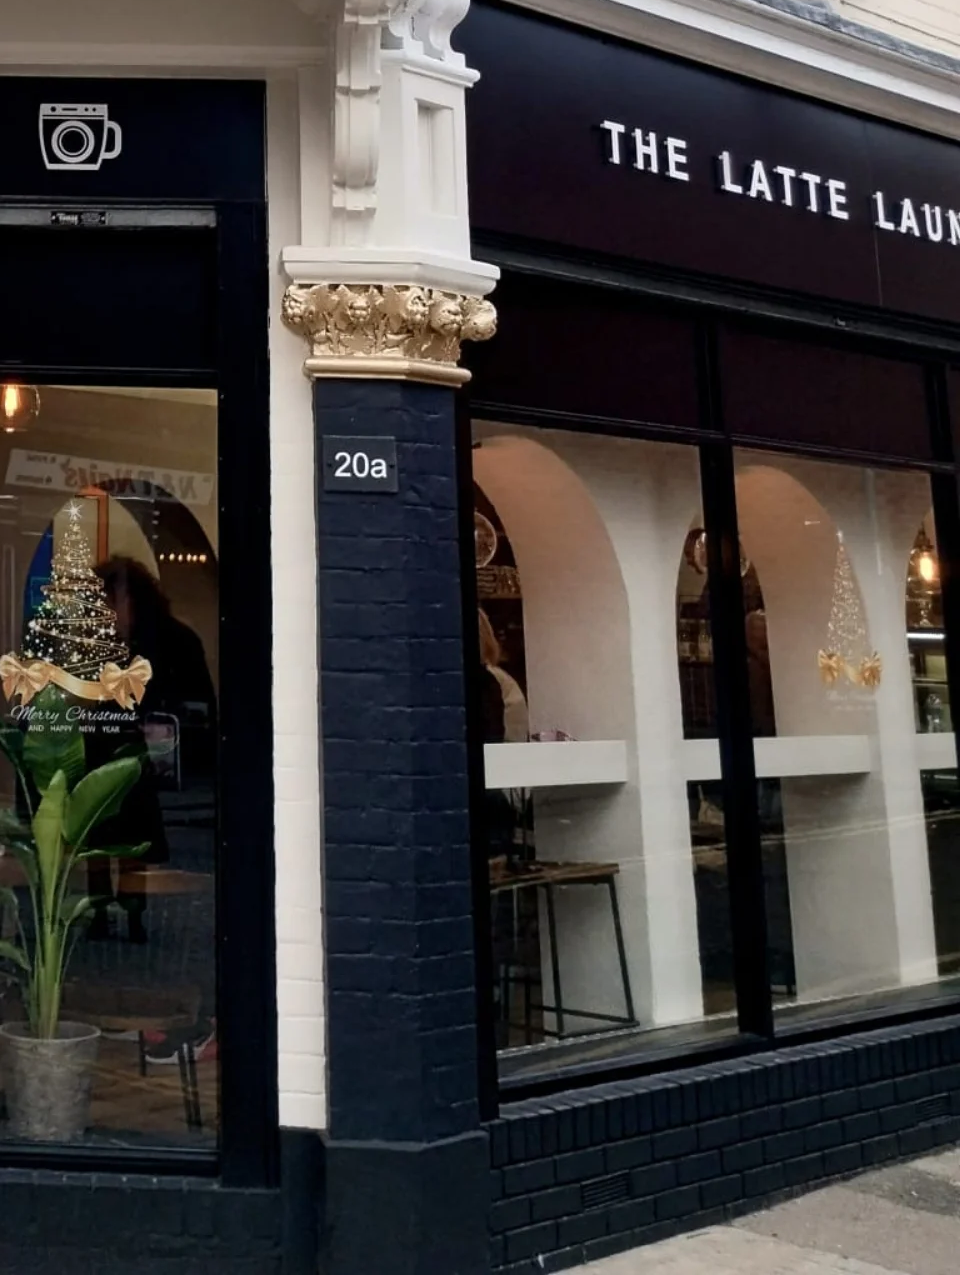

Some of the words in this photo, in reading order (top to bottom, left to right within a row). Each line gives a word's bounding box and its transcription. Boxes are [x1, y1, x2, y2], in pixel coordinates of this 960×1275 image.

[600, 120, 689, 181] THE
[719, 151, 849, 219] LATTE
[334, 451, 387, 478] 20a
[10, 705, 60, 724] Merry
[65, 706, 137, 722] Christmas
[78, 725, 96, 733] NEW
[102, 725, 120, 733] YEAR
